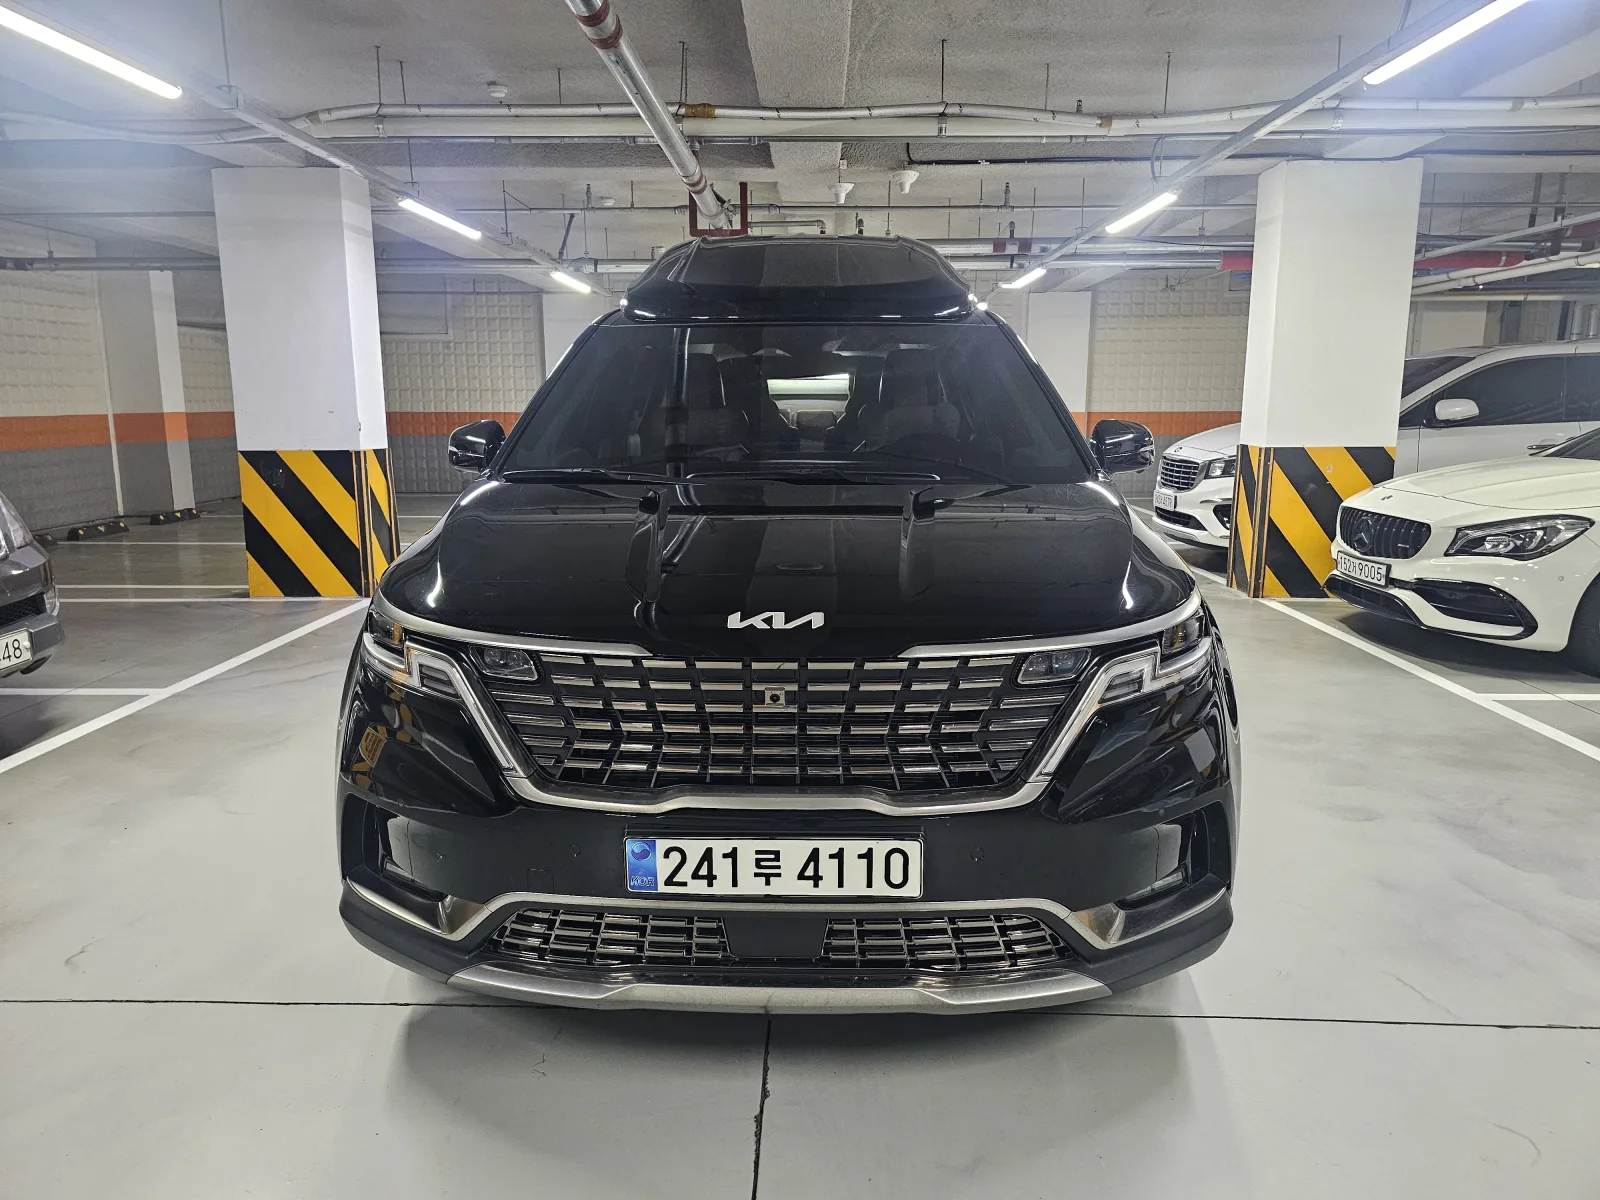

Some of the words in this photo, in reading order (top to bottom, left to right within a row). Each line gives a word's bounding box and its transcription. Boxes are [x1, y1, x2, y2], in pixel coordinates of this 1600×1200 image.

[1358, 562, 1382, 581] 9005
[727, 611, 825, 630] KIA
[0, 639, 22, 662] 48
[663, 846, 782, 888] 241루
[797, 847, 910, 890] 4110
